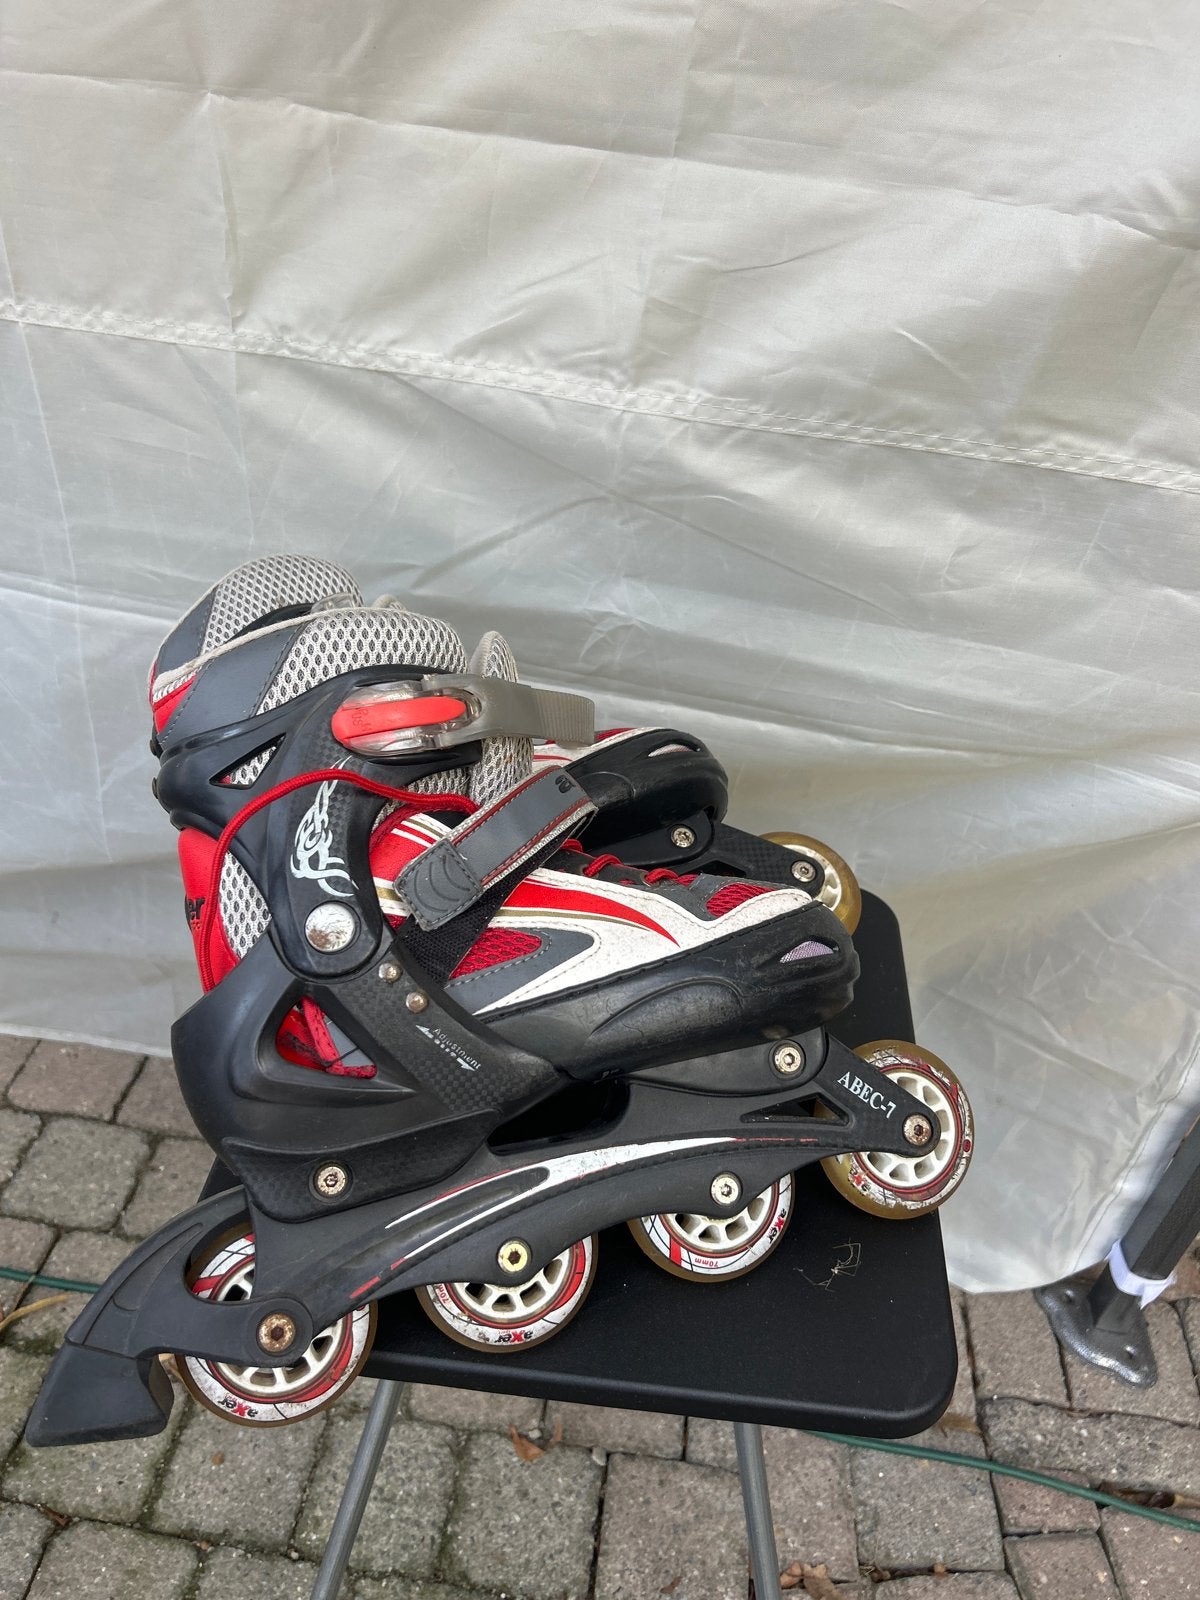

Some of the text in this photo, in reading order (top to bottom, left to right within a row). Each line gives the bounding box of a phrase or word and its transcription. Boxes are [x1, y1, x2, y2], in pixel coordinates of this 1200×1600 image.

[433, 1028, 482, 1069] Adjustment
[837, 1071, 897, 1119] ABEC-7
[694, 1257, 719, 1268] 70mm
[437, 1283, 450, 1304] 70m
